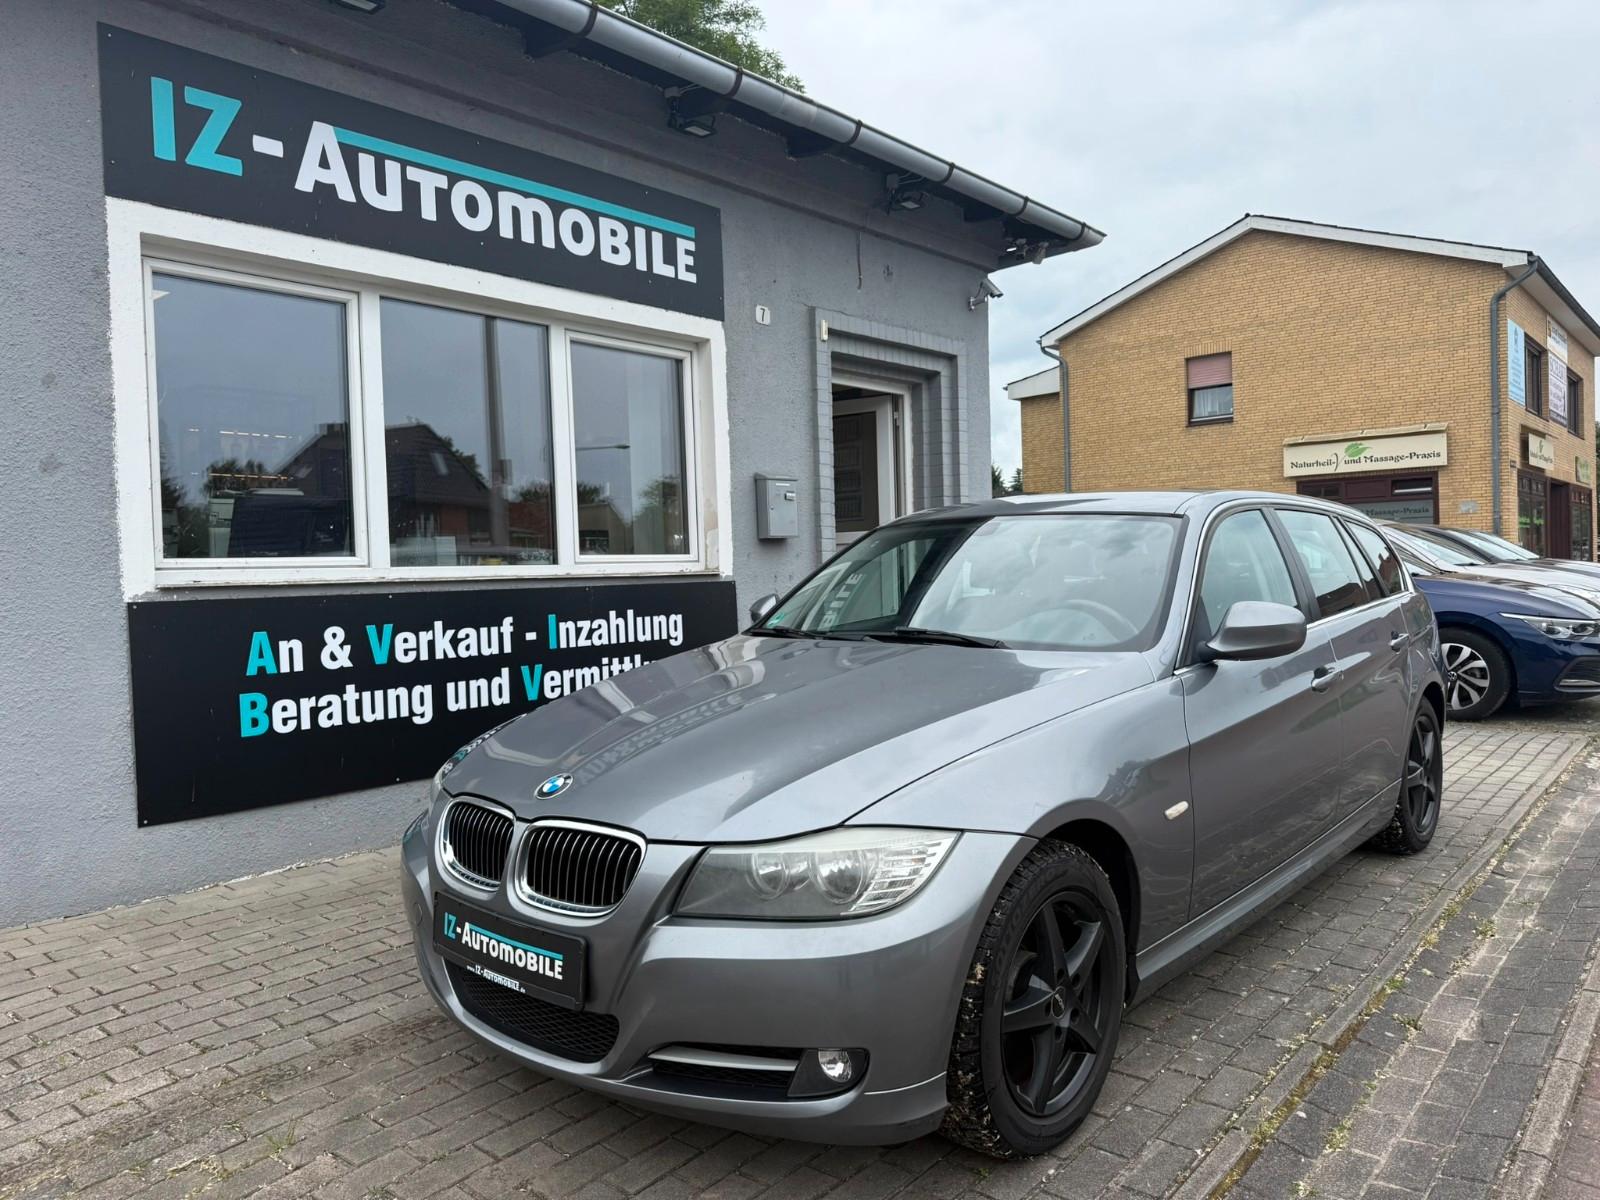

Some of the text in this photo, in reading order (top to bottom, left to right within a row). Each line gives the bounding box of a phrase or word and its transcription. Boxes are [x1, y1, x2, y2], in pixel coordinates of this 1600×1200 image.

[760, 307, 766, 322] 7
[1344, 456, 1362, 465] und
[1364, 450, 1441, 464] Massage-Praxis
[245, 631, 304, 676] An
[320, 626, 354, 670] &
[366, 616, 514, 664] Verkauf
[548, 609, 684, 650] Inzahlung
[239, 653, 656, 738] Beratung und Vermitt
